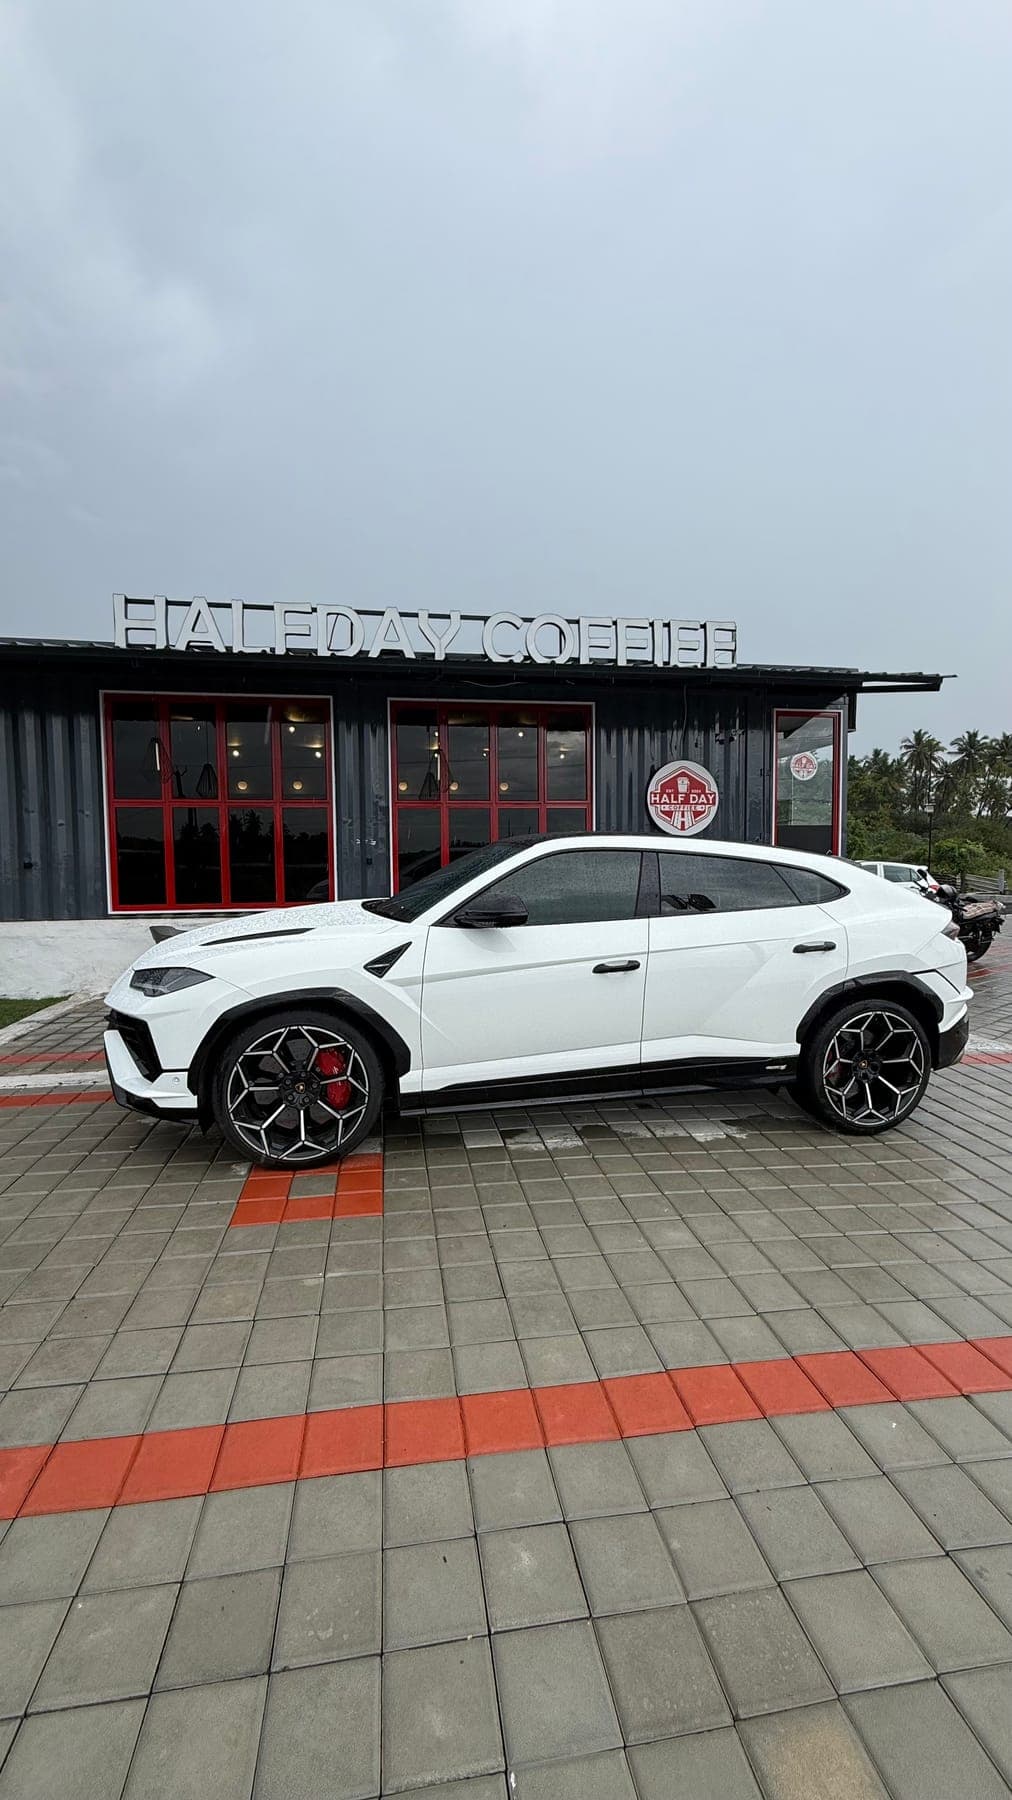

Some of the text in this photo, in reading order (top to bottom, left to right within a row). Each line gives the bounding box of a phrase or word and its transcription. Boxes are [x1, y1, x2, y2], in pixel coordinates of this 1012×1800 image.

[482, 611, 737, 669] COFFIEE
[650, 793, 715, 804] HALF DAY
